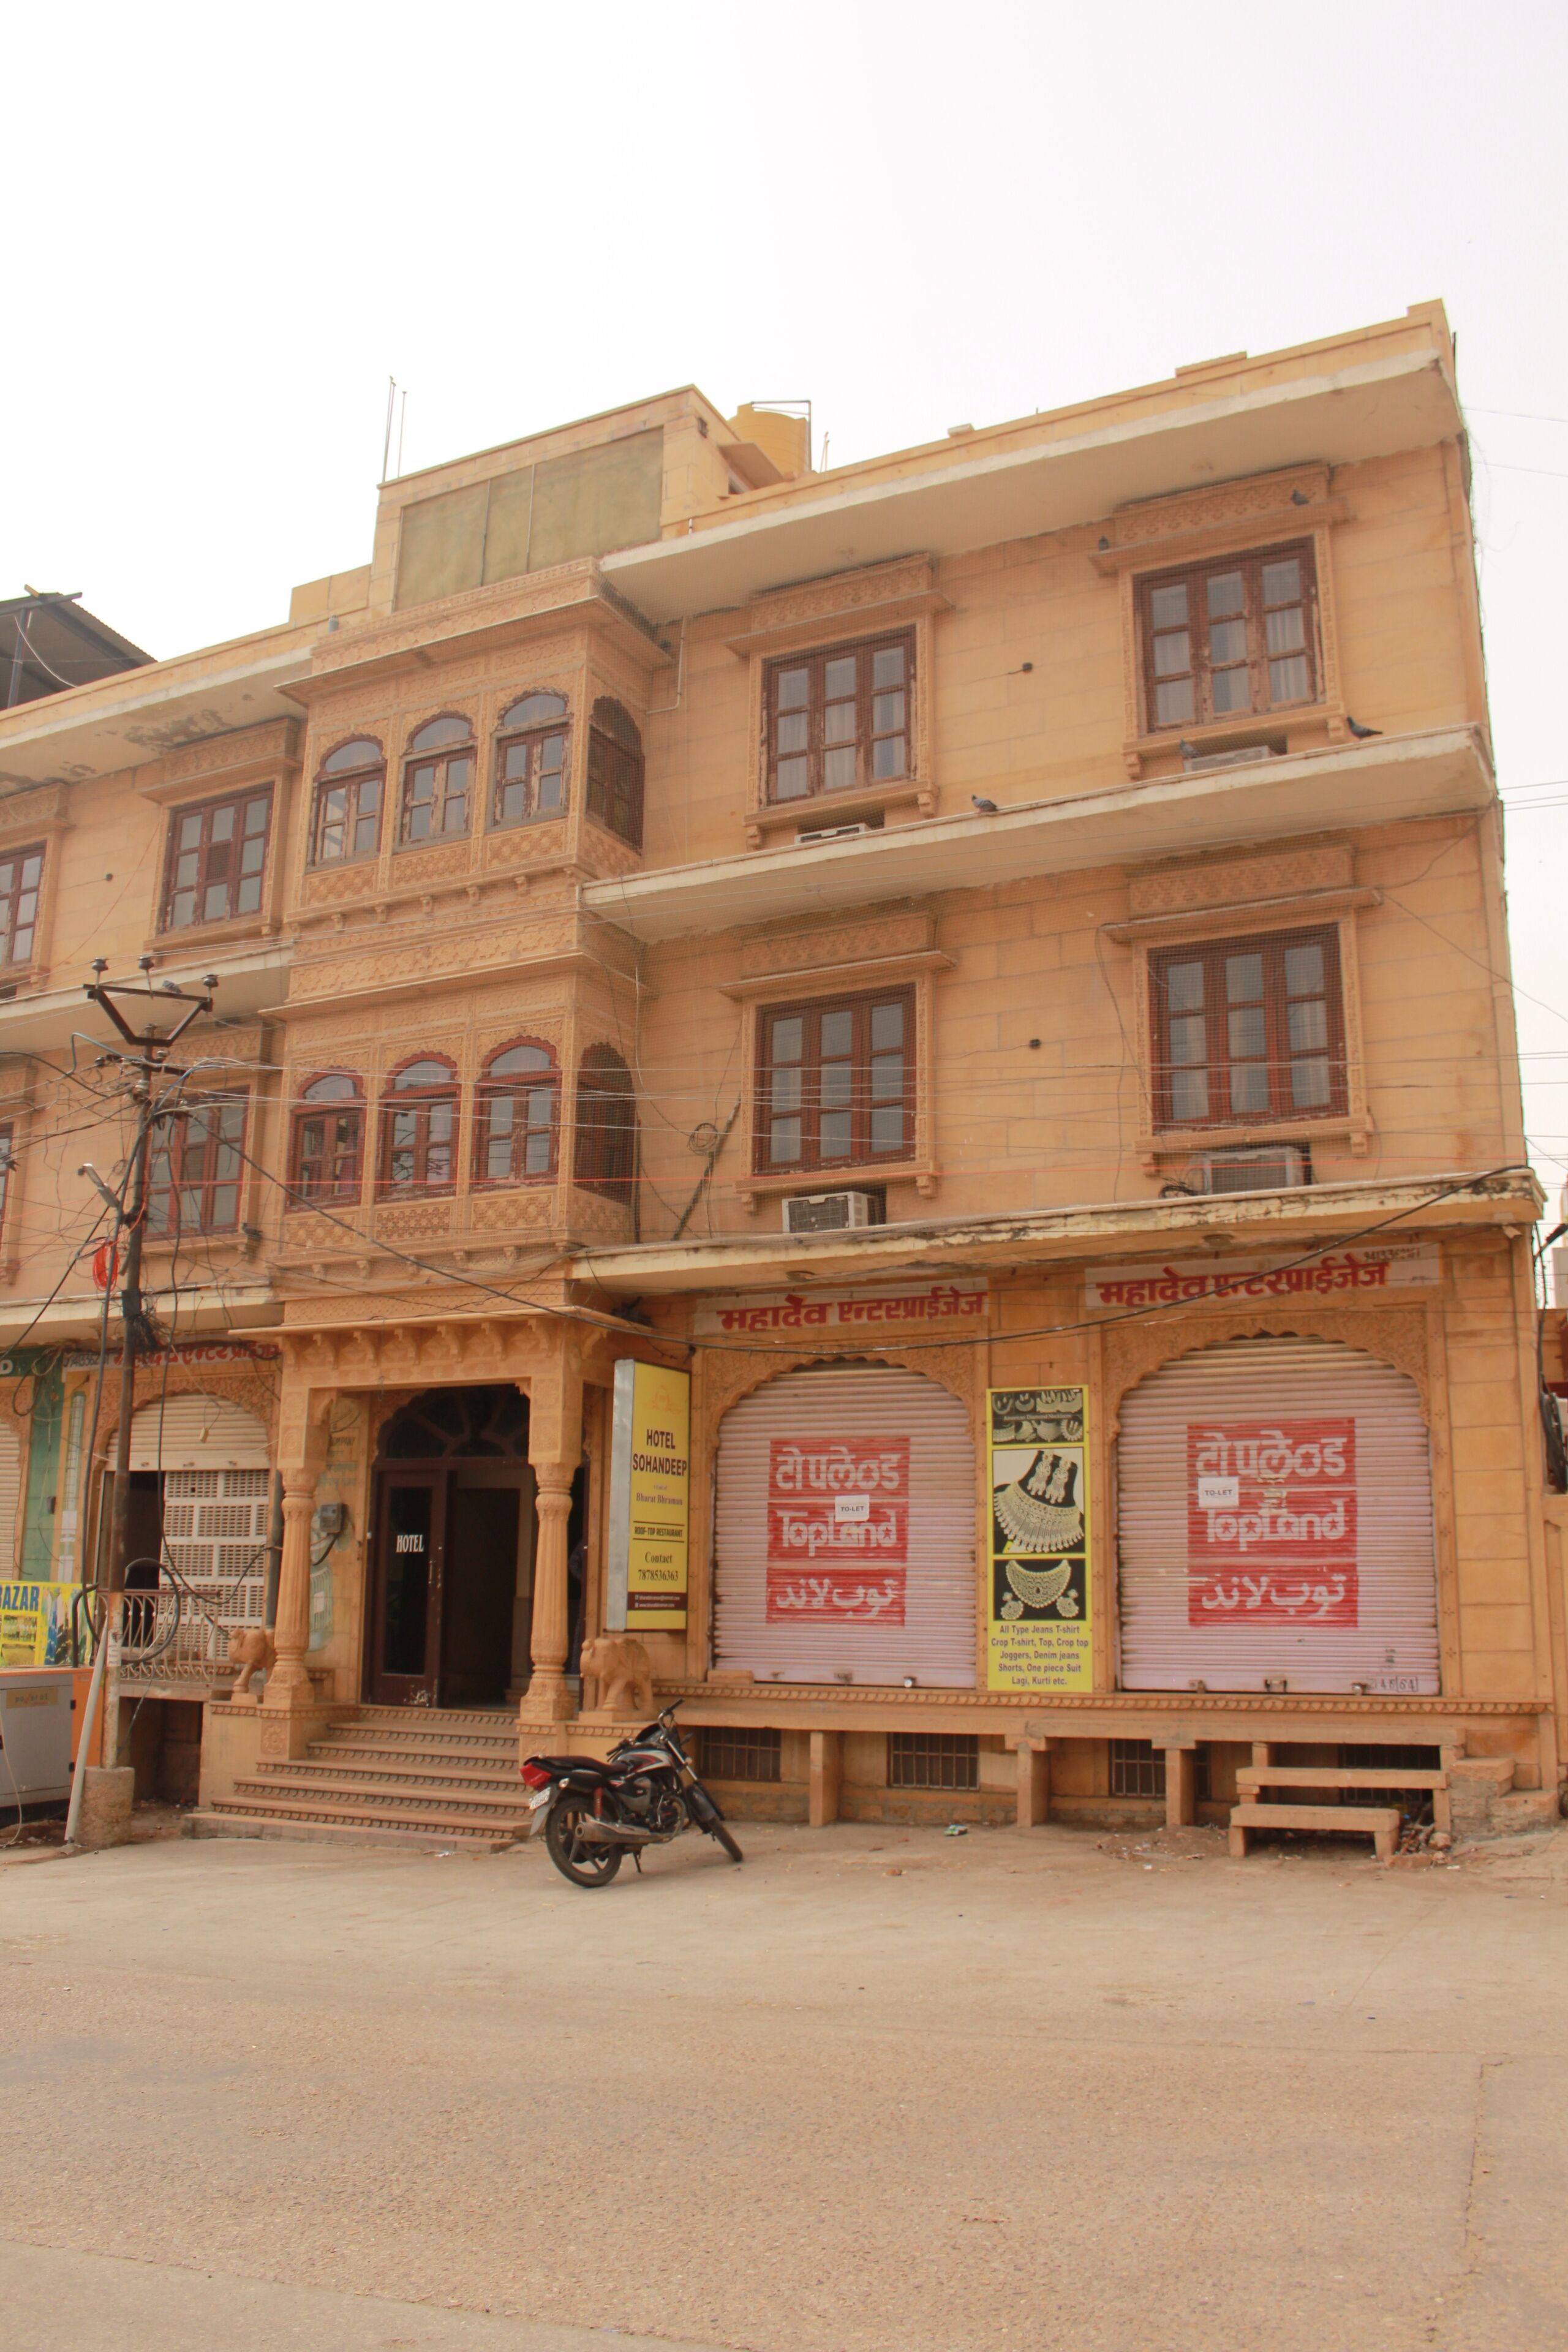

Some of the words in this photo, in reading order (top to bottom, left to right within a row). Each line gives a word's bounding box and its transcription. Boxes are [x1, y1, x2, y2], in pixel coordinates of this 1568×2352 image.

[1096, 1265, 1210, 1307] महादेव
[717, 1294, 834, 1332] महादेव
[646, 1429, 676, 1449] HOTEL
[633, 1453, 687, 1476] SOHANDEEP
[636, 1493, 656, 1502] Bharat
[657, 1494, 682, 1505] Bhraman
[635, 1526, 655, 1536] ROOF-TOP
[657, 1528, 682, 1537] RESTAURANT
[396, 1534, 424, 1553] HOTEL
[645, 1551, 673, 1563] Contact
[638, 1569, 679, 1581] 7878536363
[0, 1584, 39, 1611] AZAR
[1000, 1625, 1009, 1634] All
[1012, 1625, 1029, 1635] Type
[1031, 1625, 1053, 1634] Jeans
[1056, 1625, 1080, 1634] T-shirt
[991, 1638, 1008, 1648] Crop
[1011, 1638, 1036, 1648] T-shirt,
[1039, 1638, 1054, 1648] Top,
[1057, 1638, 1074, 1648] Crop
[1076, 1638, 1088, 1648] top
[1000, 1651, 1031, 1660] Joggers,
[1034, 1651, 1057, 1659] Denim
[1059, 1651, 1079, 1660] jeans
[998, 1663, 1024, 1673] Shorts,
[1044, 1664, 1063, 1673] piece
[1066, 1663, 1081, 1672] Suit
[1012, 1676, 1029, 1686] Lagi,
[1032, 1676, 1050, 1684] Kurti
[1053, 1676, 1067, 1685] etc.
